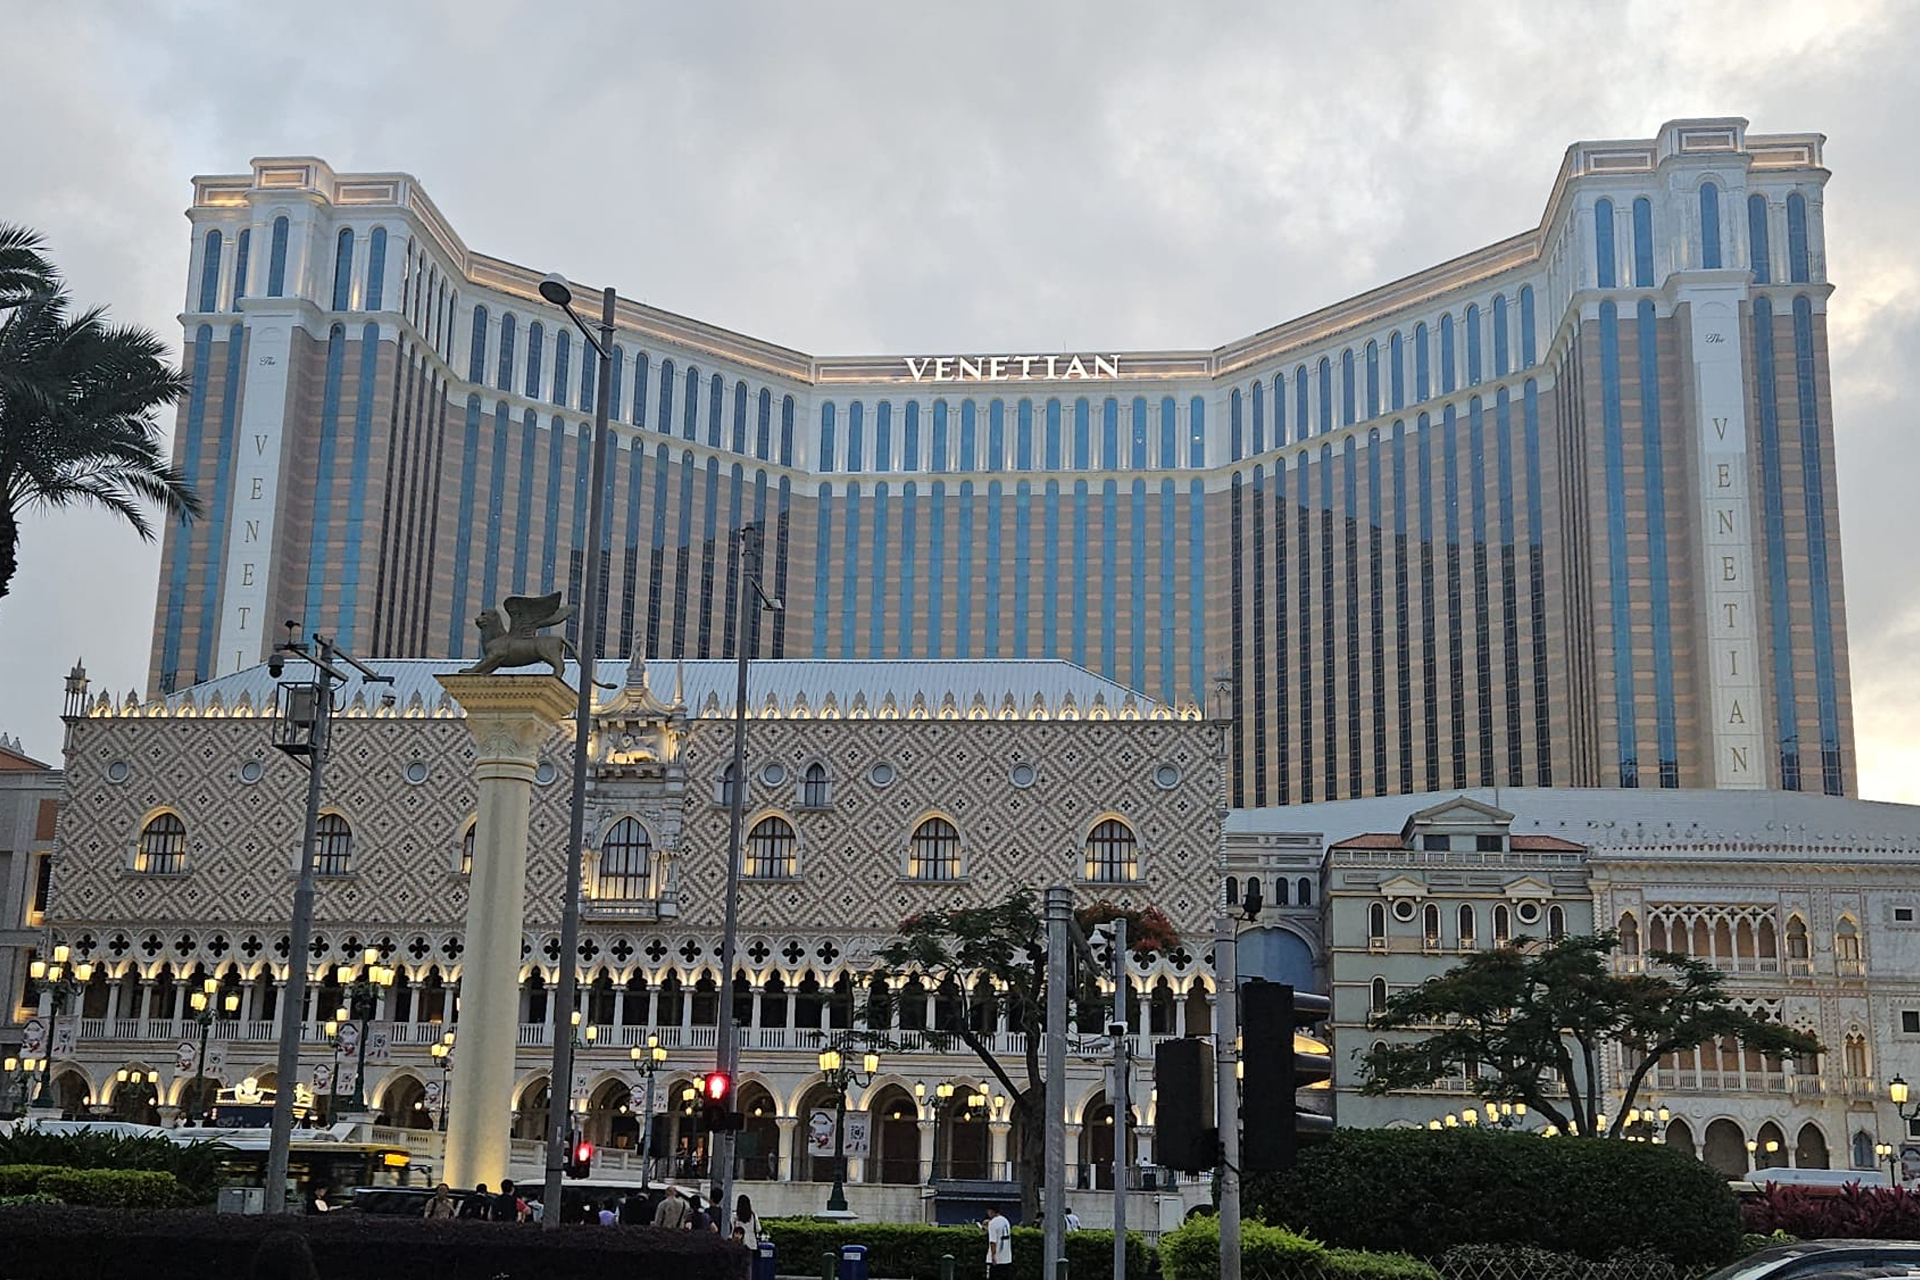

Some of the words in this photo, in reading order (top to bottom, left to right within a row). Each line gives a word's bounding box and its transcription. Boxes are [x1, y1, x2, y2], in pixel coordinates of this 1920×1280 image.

[903, 354, 1121, 382] VENETIAN
[236, 435, 268, 672] VENETI
[1712, 418, 1748, 773] VENETIAN
